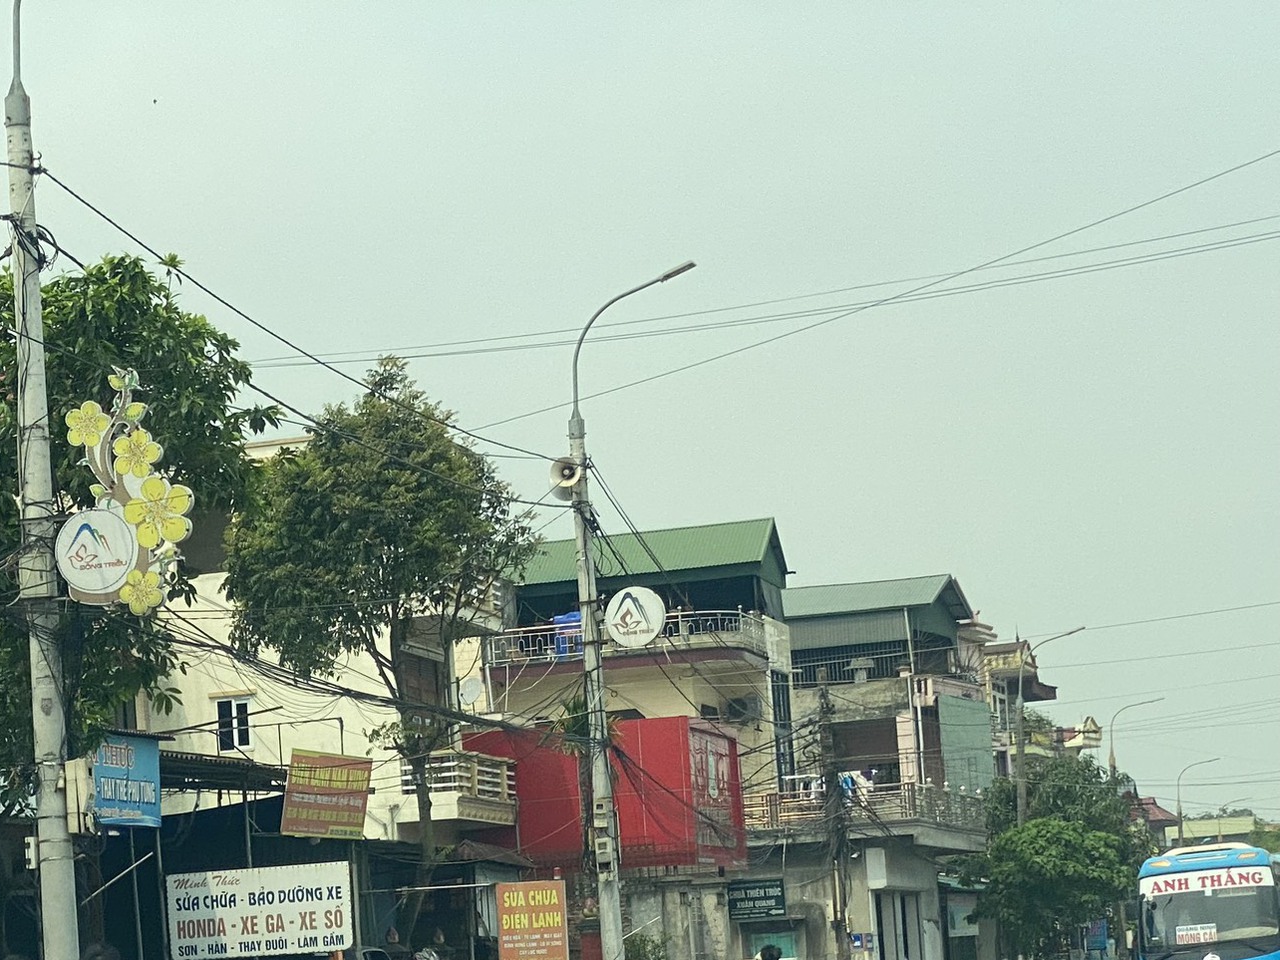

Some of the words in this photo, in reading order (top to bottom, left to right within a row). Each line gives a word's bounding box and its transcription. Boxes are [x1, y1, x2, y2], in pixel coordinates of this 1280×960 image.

[173, 877, 208, 890] Minh
[212, 875, 241, 887] Thức
[1150, 877, 1190, 894] ANH
[1198, 868, 1263, 889] THẮNG
[176, 891, 200, 911] SỬA
[203, 890, 236, 909] CHỮA
[248, 886, 275, 906] BẢO
[278, 885, 322, 904] DƯỠNG
[326, 885, 342, 900] XE
[177, 916, 227, 940] HONDA
[240, 915, 259, 936] XE
[265, 913, 285, 934] GA
[299, 910, 318, 931] XE
[324, 902, 344, 930] SỐ
[178, 944, 198, 957] SƠN
[207, 941, 227, 955] HÀN
[238, 940, 262, 952] THAY
[297, 935, 318, 948] LÀM
